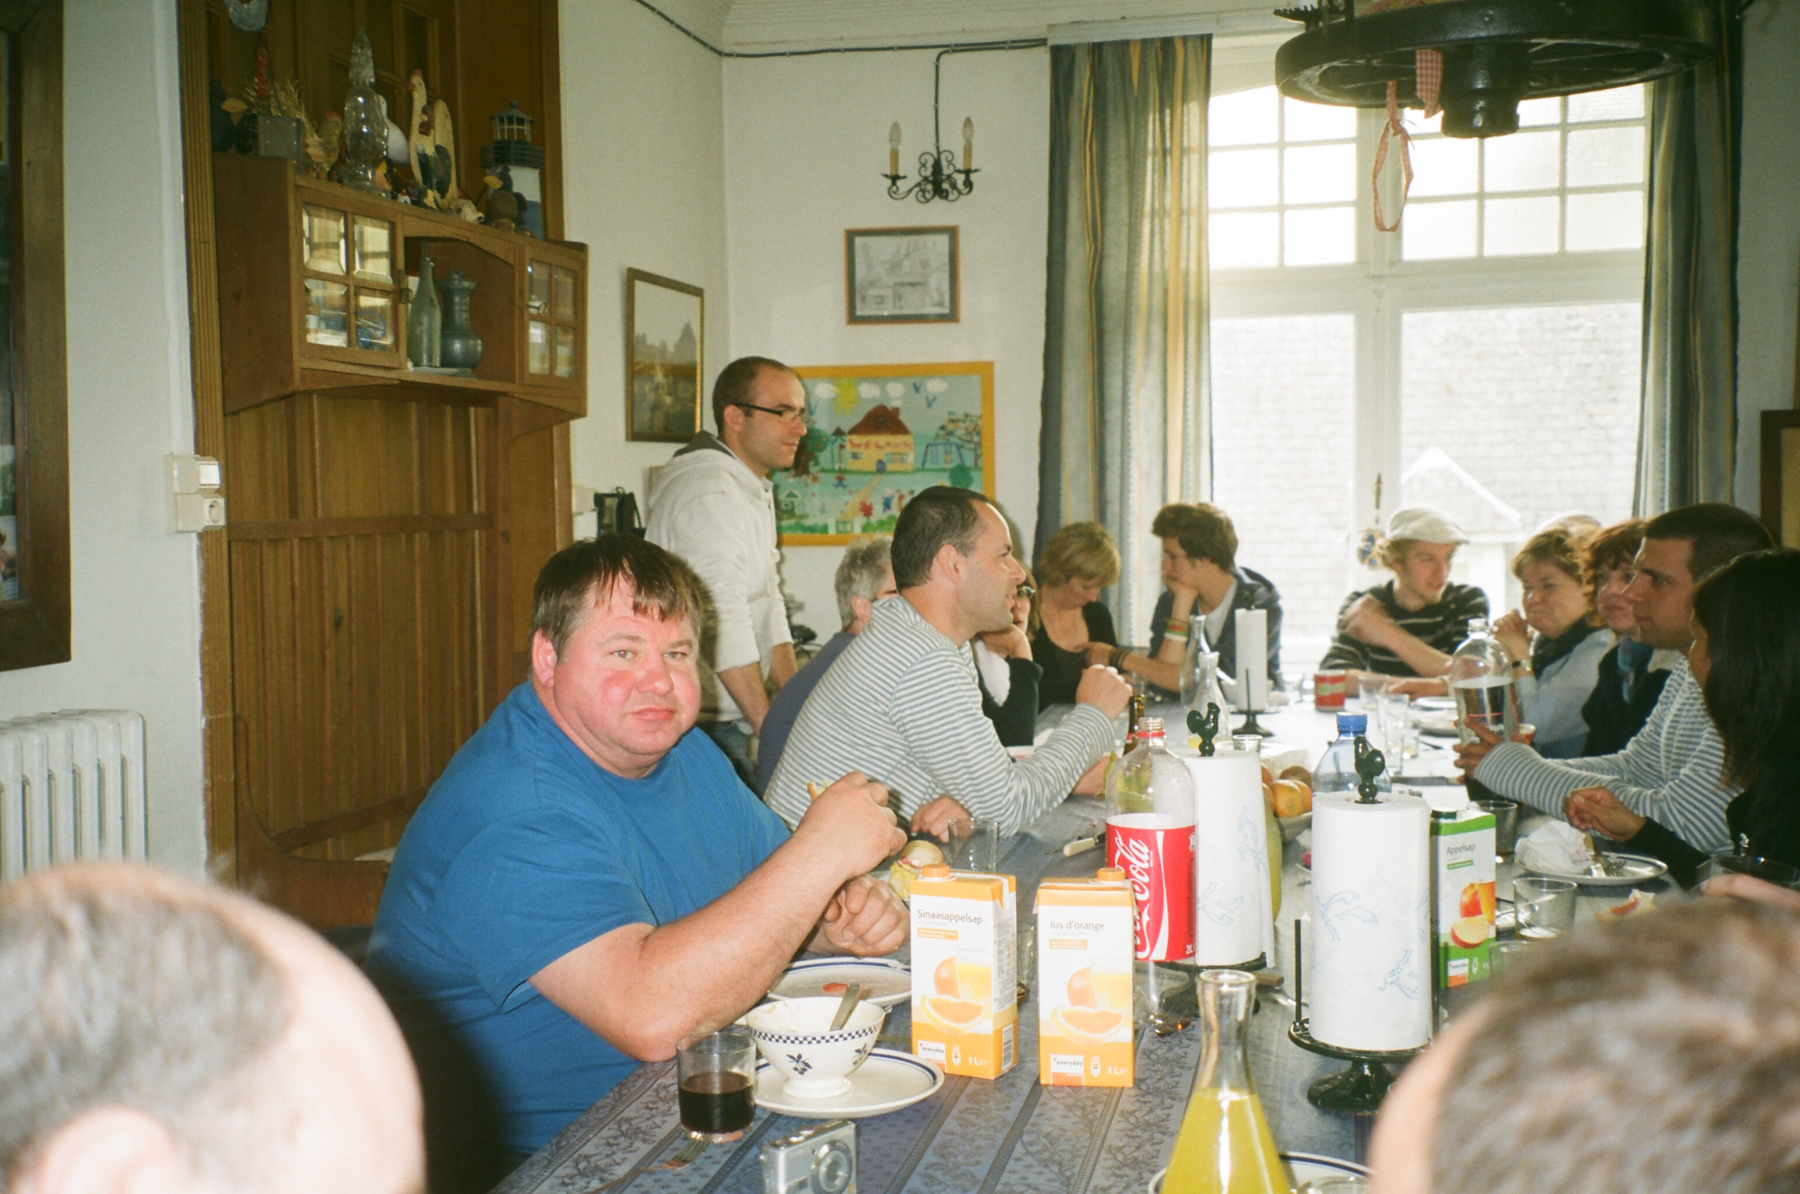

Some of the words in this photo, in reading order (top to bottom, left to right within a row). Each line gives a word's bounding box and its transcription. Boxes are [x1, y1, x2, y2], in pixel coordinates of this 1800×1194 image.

[1446, 843, 1476, 856] Appelsap
[917, 909, 983, 925] Sinaasappelsap
[1049, 921, 1064, 930] Jus
[1066, 920, 1105, 932] d'orange
[922, 1046, 945, 1054] everyday
[1056, 1059, 1083, 1067] everyday
